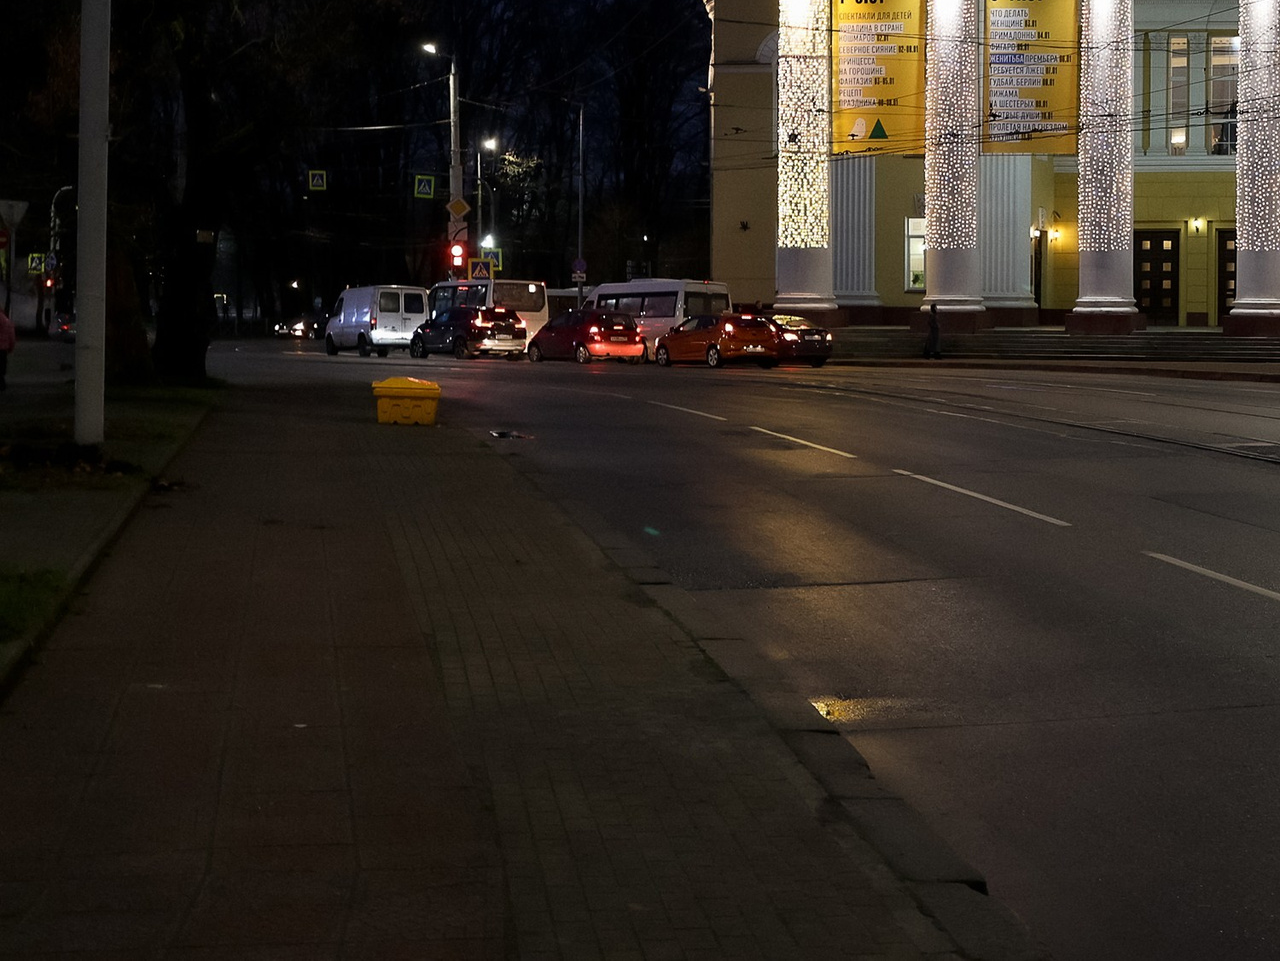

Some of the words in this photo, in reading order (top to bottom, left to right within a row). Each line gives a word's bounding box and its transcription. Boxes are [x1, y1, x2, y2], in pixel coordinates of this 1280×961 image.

[839, 12, 876, 21] СПЕКТАКЛИ
[877, 11, 891, 21] ДЛЯ
[892, 10, 912, 21] ДЕТЕЙ
[990, 9, 1003, 18] ЧТО
[1003, 9, 1029, 18] ДЕЛАТЬ
[874, 24, 879, 32] В
[880, 23, 904, 32] СТРАНЕ
[990, 20, 1024, 28] ЖЕНЩИНЕ
[839, 33, 876, 42] КОШМАРОВ
[990, 31, 1037, 40] ПРИМАДОННЫ
[839, 45, 870, 54] СЕВЕРНОЕ
[871, 45, 897, 54] СИЯНИЕ
[990, 43, 1016, 51] ФИГАРО
[839, 57, 876, 66] ПРИНЦЕССА
[990, 54, 1024, 63] ЖЕНИТЬБА
[1025, 54, 1058, 63] ПРЕМЬЕРА
[839, 67, 848, 76] НА
[990, 66, 1025, 75] ТРЕБУЕТСЯ
[1025, 66, 1044, 75] ЛЖЕЦ
[839, 77, 873, 86] ФАНТАЗИЯ
[1016, 78, 1041, 86] БЕРЛИН
[839, 88, 862, 97] РЕЦЕПТ
[989, 89, 1018, 98] ПИЖАМА
[839, 98, 876, 107] ПРАЗДНИКА
[999, 100, 1035, 108] ШЕСТЕРЫХ
[1020, 111, 1040, 120] ДУШИ
[989, 123, 1021, 132] ПРОЛЕТАЯ
[1022, 123, 1036, 132] НАД
[1037, 123, 1068, 132] ГНЕЗДОМ
